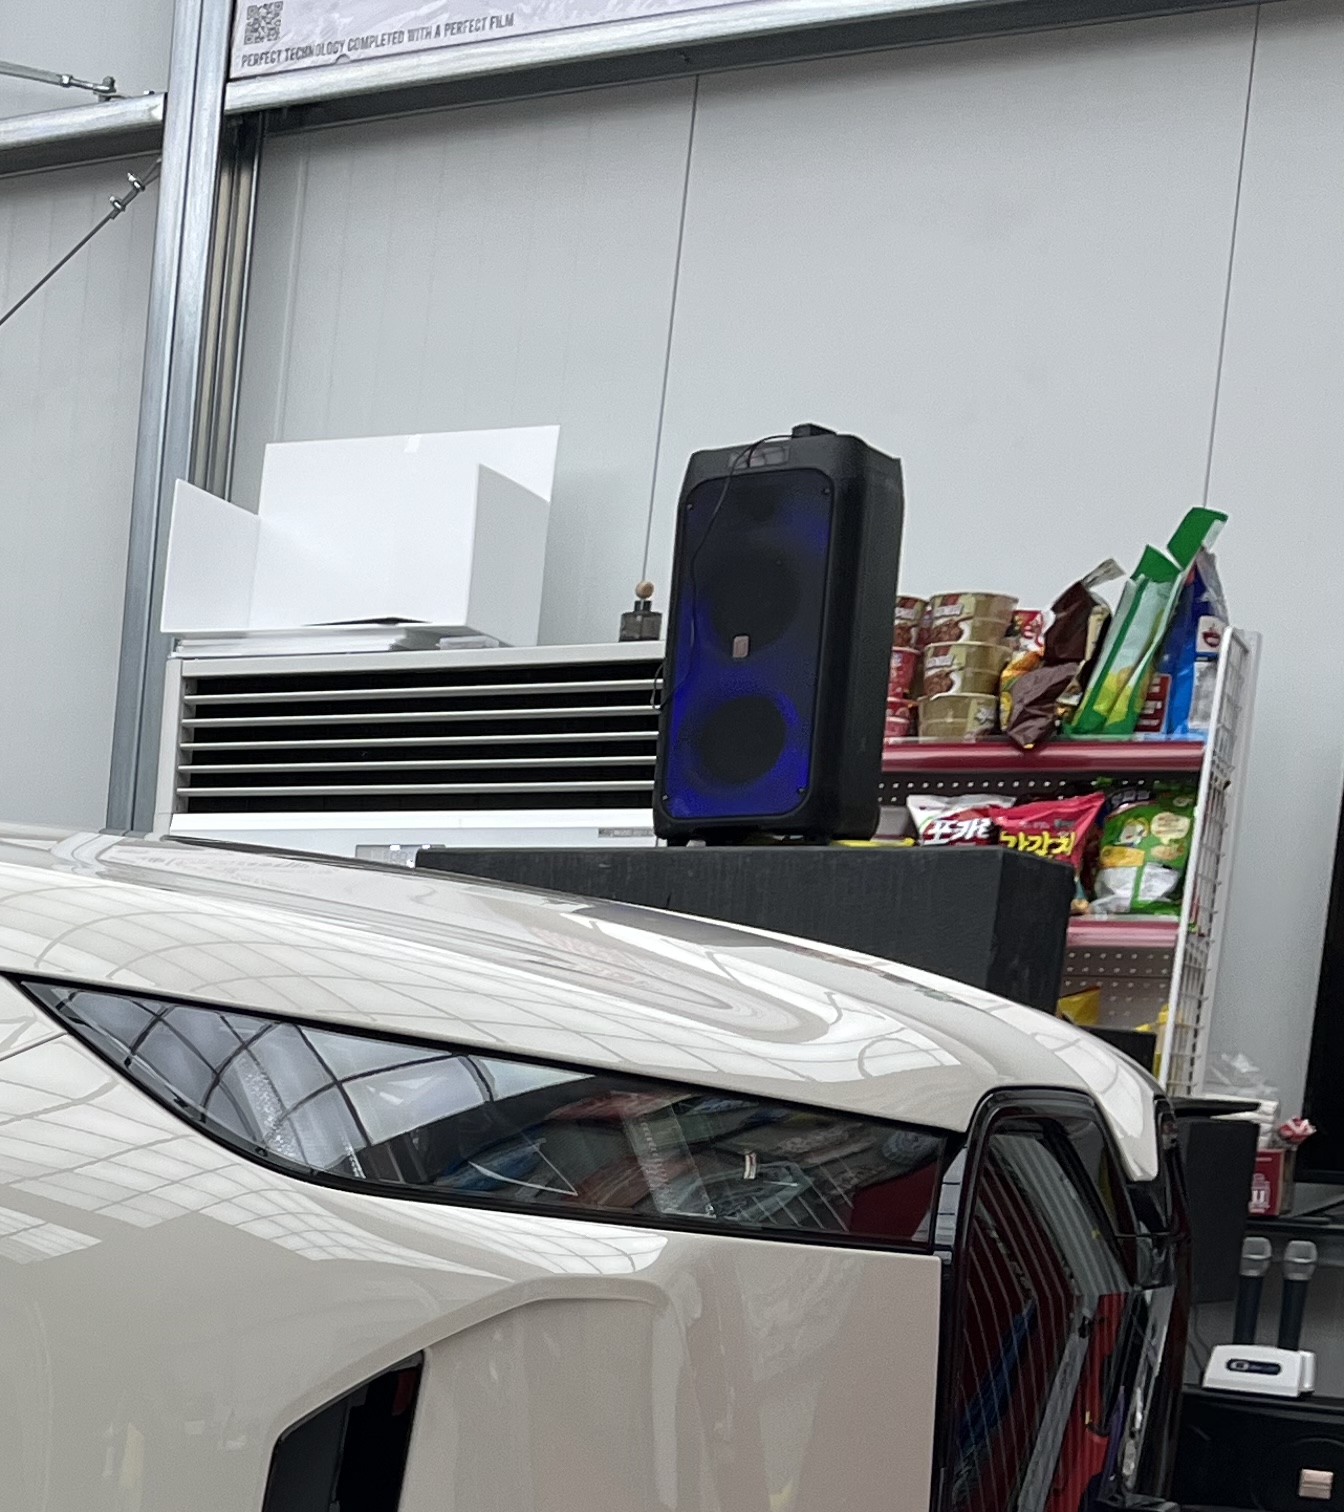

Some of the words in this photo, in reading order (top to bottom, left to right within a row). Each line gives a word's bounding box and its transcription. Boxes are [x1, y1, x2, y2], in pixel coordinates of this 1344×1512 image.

[241, 46, 283, 68] PERFECT
[284, 37, 346, 63] TECHNOLOGY
[347, 29, 406, 54] COMPLETED
[407, 26, 433, 44] WITH
[433, 23, 442, 39] A
[443, 16, 488, 39] PERFECT
[488, 12, 516, 30] FILM
